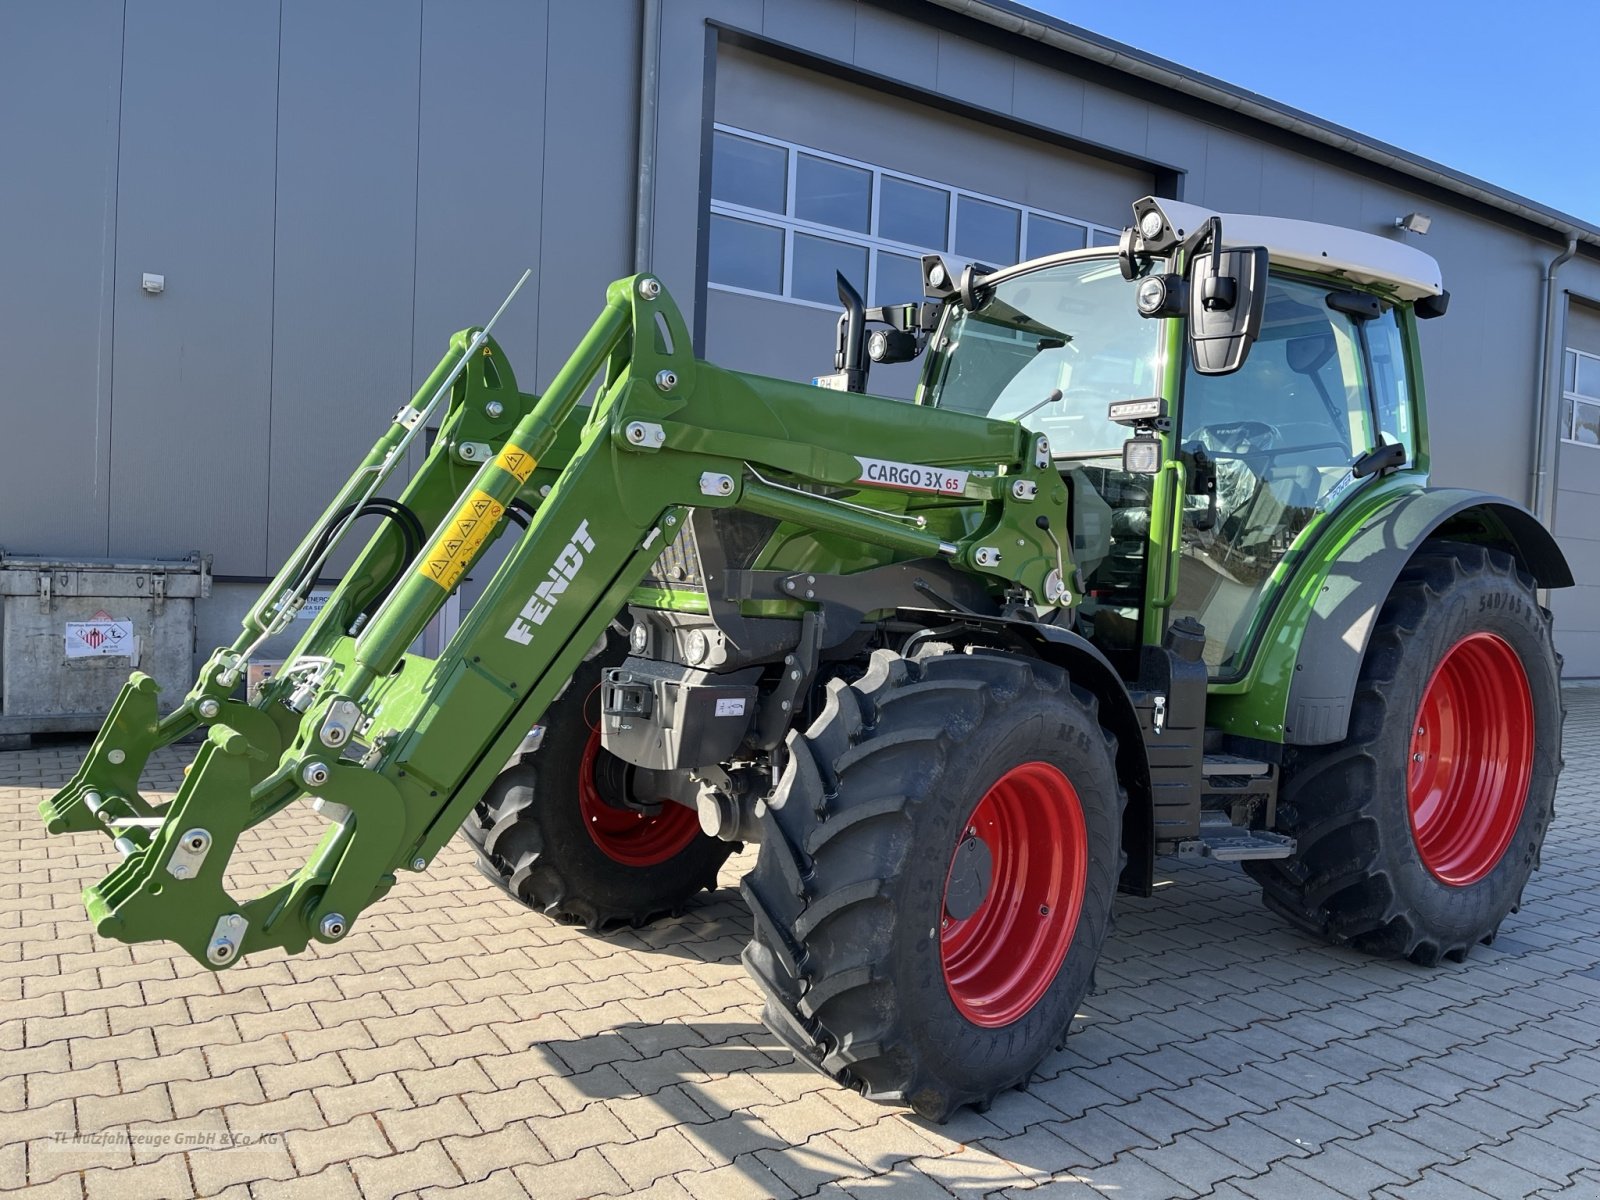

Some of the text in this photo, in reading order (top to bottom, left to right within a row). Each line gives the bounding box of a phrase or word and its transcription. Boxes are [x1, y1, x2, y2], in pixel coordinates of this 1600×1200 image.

[868, 464, 958, 490] CARGO 3X 65
[504, 518, 596, 646] FENDT
[1479, 592, 1522, 613] 540/65
